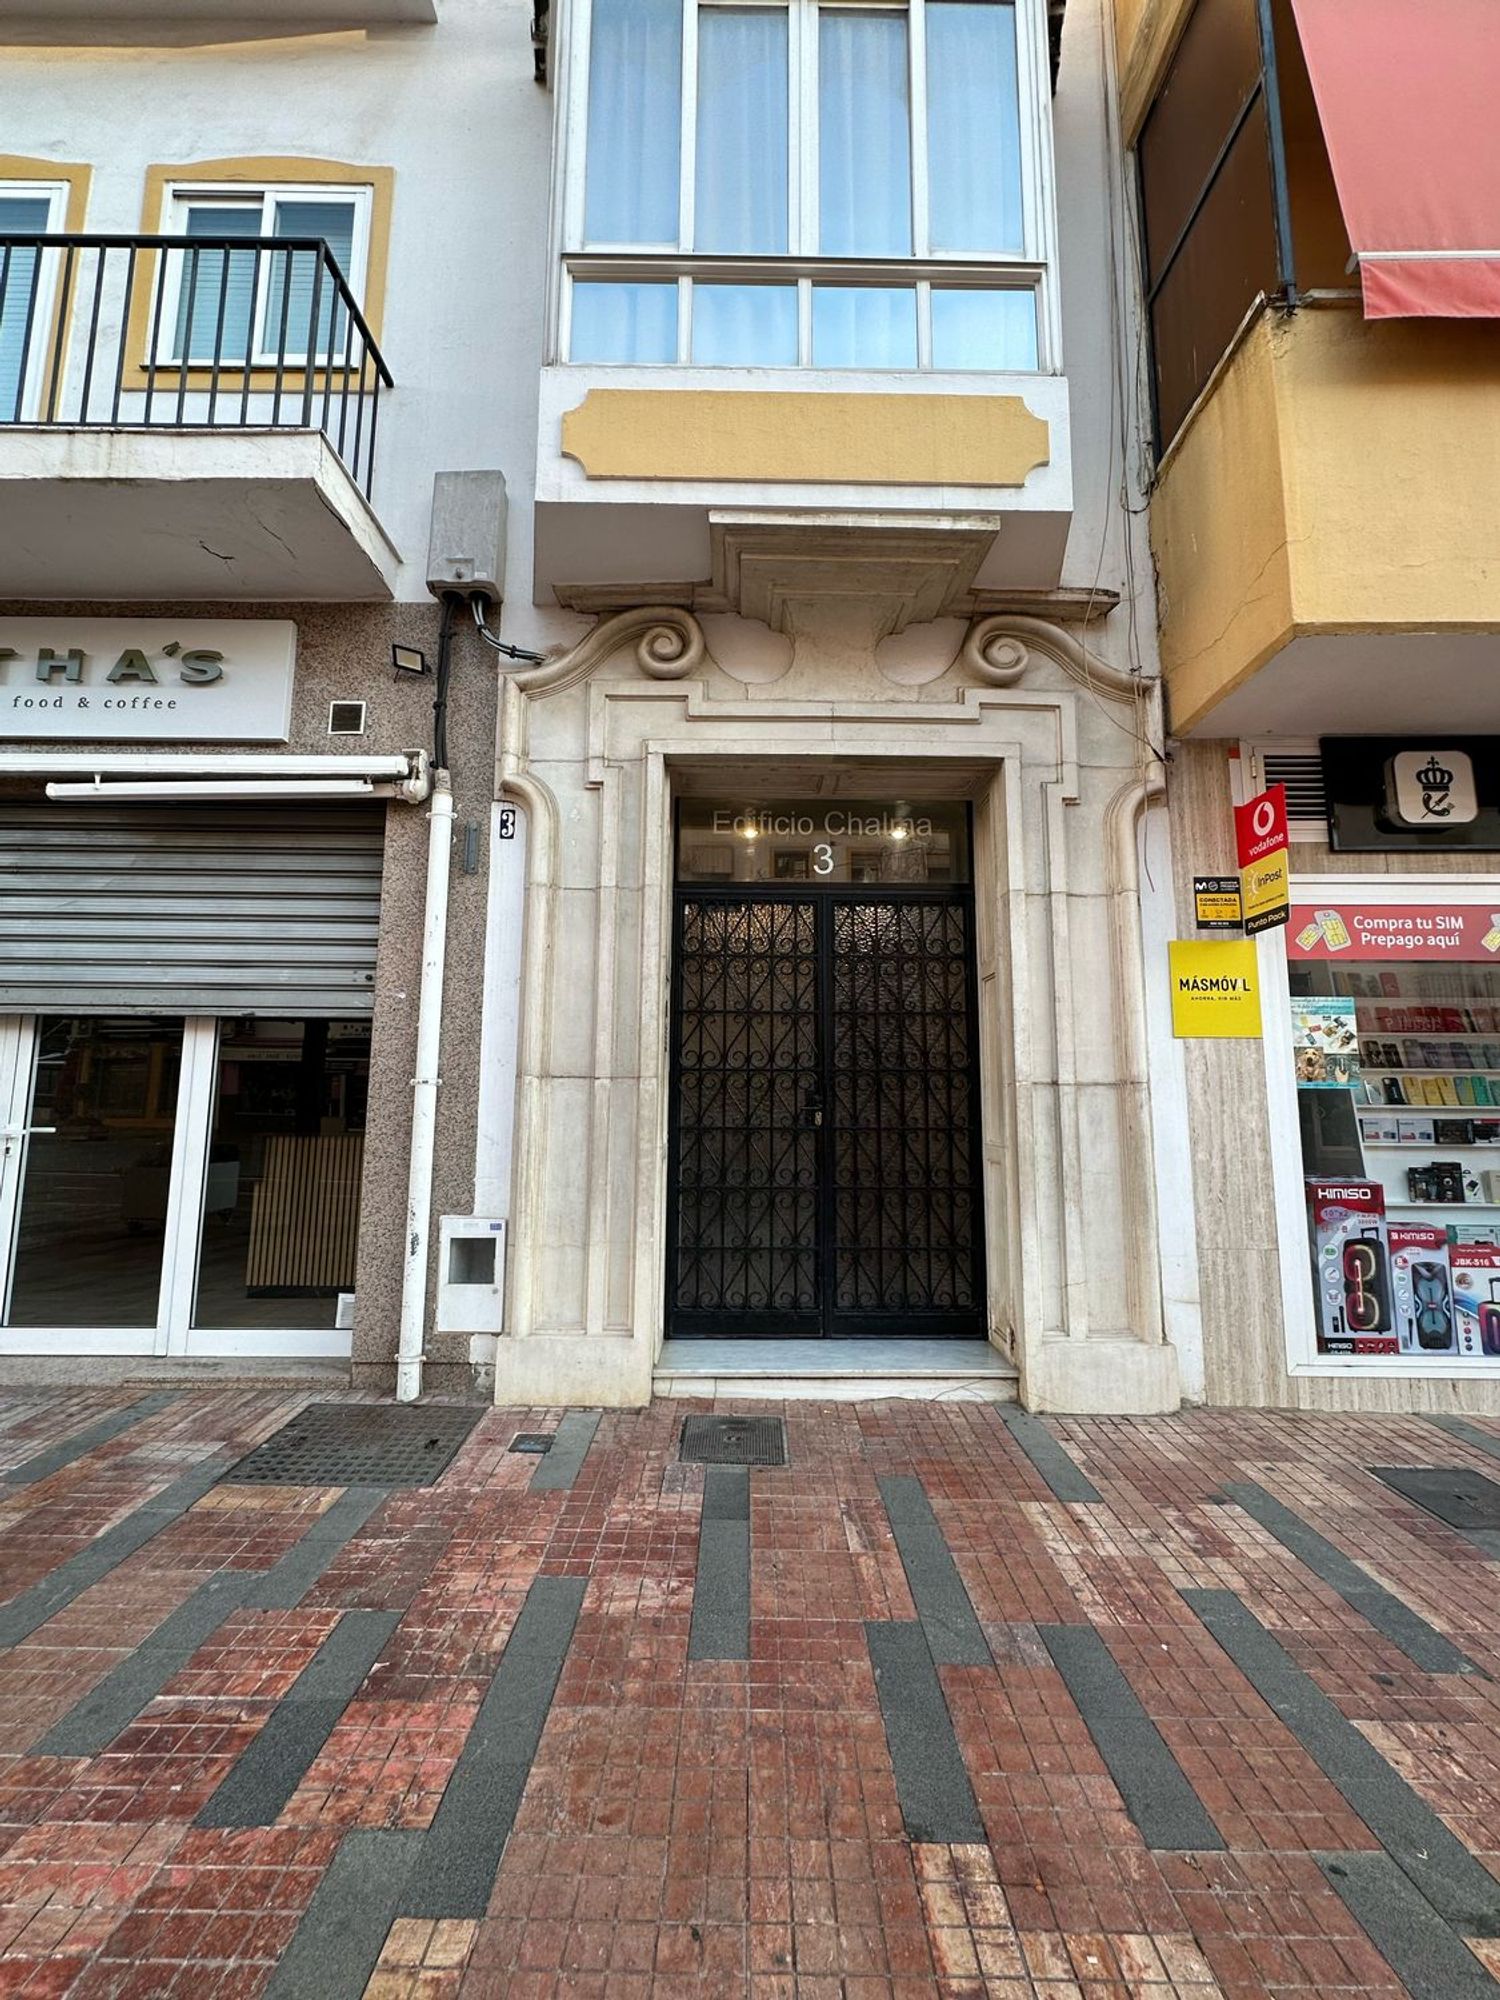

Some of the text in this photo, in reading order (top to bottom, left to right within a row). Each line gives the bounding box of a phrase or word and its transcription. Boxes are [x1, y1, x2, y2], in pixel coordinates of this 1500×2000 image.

[12, 695, 178, 709] food & coffee
[501, 811, 514, 837] 3
[712, 810, 814, 836] Edificio
[1248, 833, 1284, 857] vodafone
[813, 844, 834, 874] 3
[1248, 911, 1287, 930] Punto Pack
[1353, 916, 1464, 932] Compra tu SIM
[1361, 932, 1460, 949] Prepago aquí
[1318, 1187, 1371, 1200] KIMISO
